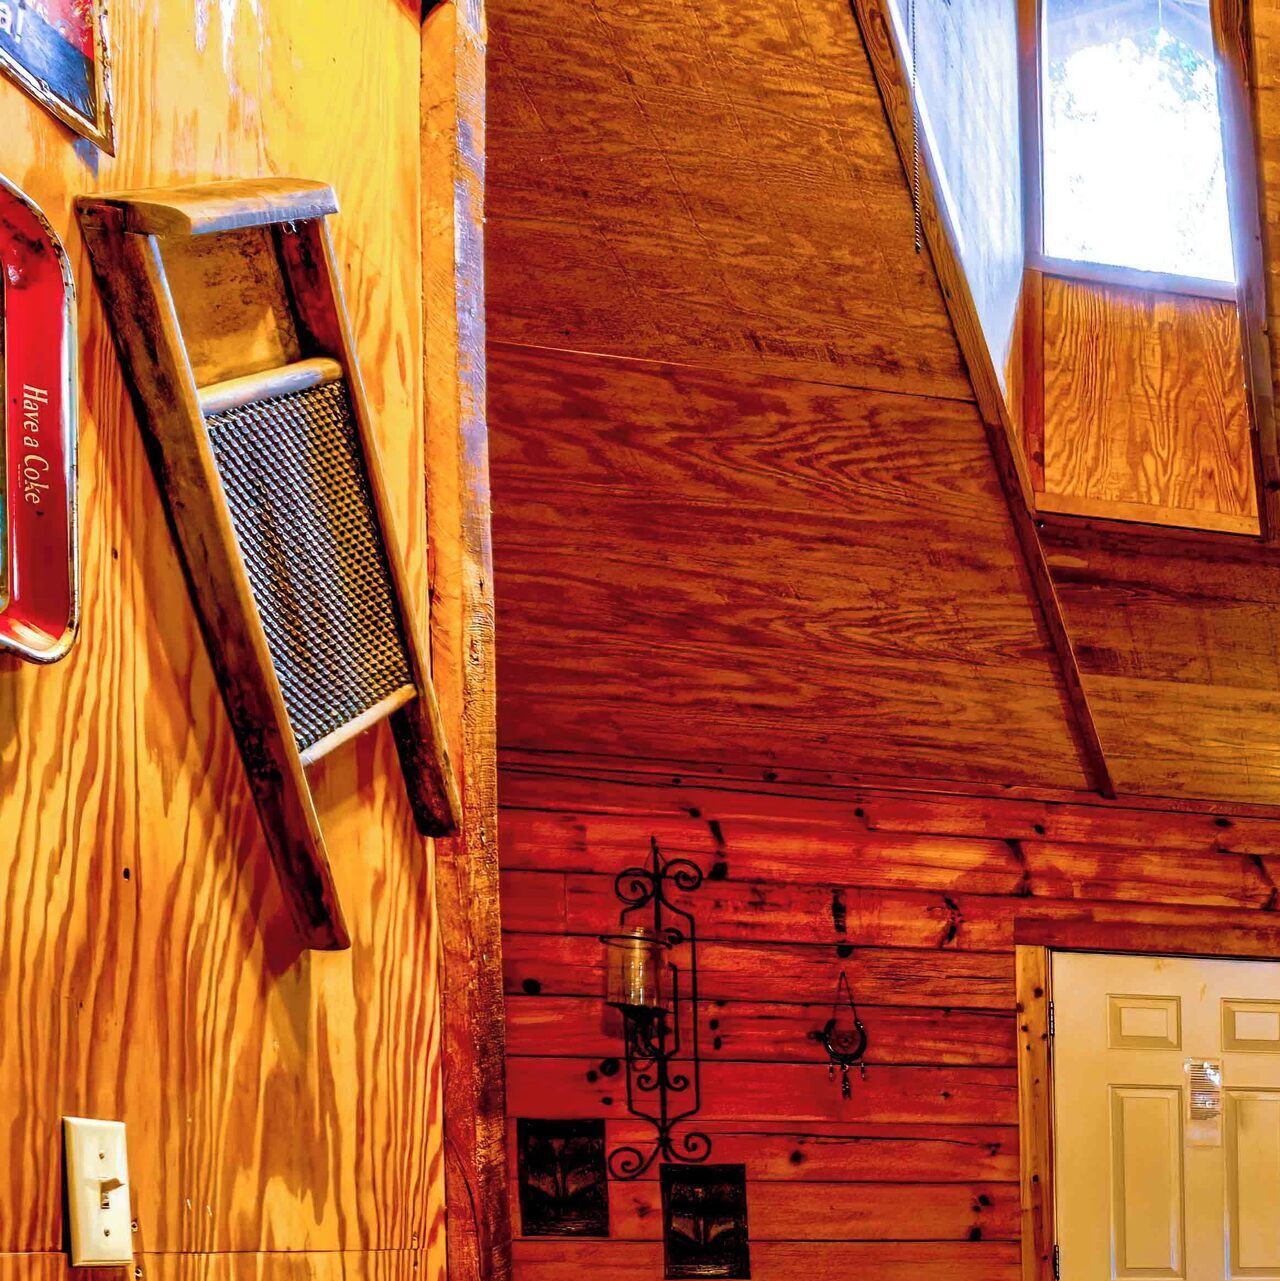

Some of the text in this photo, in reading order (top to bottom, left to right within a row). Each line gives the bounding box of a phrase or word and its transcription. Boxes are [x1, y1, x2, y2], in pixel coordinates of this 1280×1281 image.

[23, 384, 49, 504] Have a Coke
